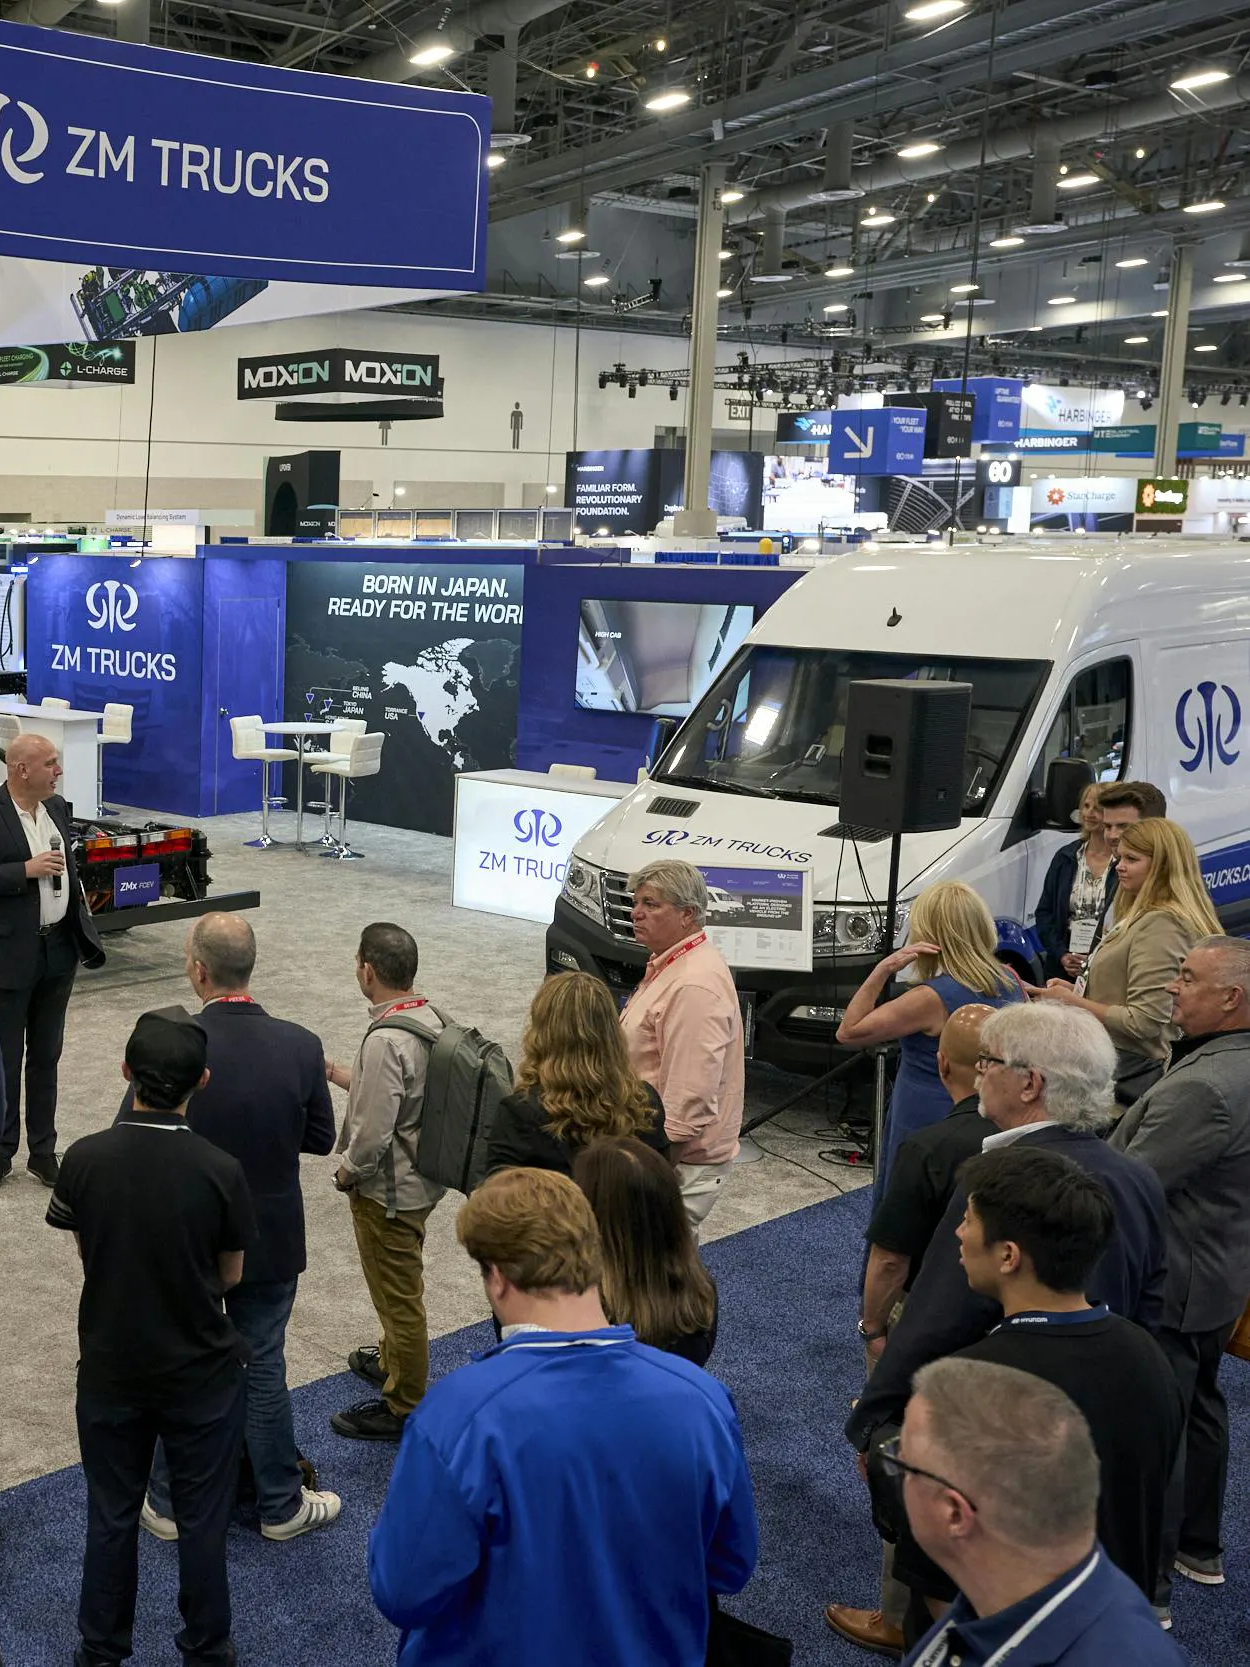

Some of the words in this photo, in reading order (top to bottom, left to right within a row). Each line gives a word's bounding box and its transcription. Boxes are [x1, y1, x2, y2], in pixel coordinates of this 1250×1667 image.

[65, 127, 135, 183] ZM
[151, 138, 330, 203] TRUCKS
[77, 365, 128, 376] L-CHARGE
[244, 360, 330, 389] MOXION
[344, 360, 432, 386] MOXION
[730, 405, 750, 417] EXIT
[1058, 408, 1112, 423] HARBINGER
[1014, 437, 1078, 448] HARBINGER
[576, 484, 610, 493] FAMILIAR
[612, 483, 637, 492] FORM.
[576, 495, 643, 504] REVOLUTIONARY
[576, 506, 630, 516] FOUNDATION.
[362, 574, 412, 595] BORN
[417, 576, 436, 595] IN
[441, 577, 509, 599] JAPAN.
[327, 596, 385, 618] READY
[389, 599, 428, 619] FOR
[432, 601, 470, 621] THE
[51, 644, 82, 671] ZM
[86, 648, 177, 681] TRUCKS
[352, 692, 372, 700] CHINA
[342, 707, 364, 715] JAPAN
[384, 712, 399, 720] USA
[689, 836, 724, 847] ZM
[727, 839, 812, 863] TRUCKS
[479, 851, 506, 873] ZM
[513, 856, 566, 882] TRUC
[1203, 864, 1250, 889] RUCKS.C
[120, 882, 137, 892] ZMx
[138, 881, 155, 889] FCEV
